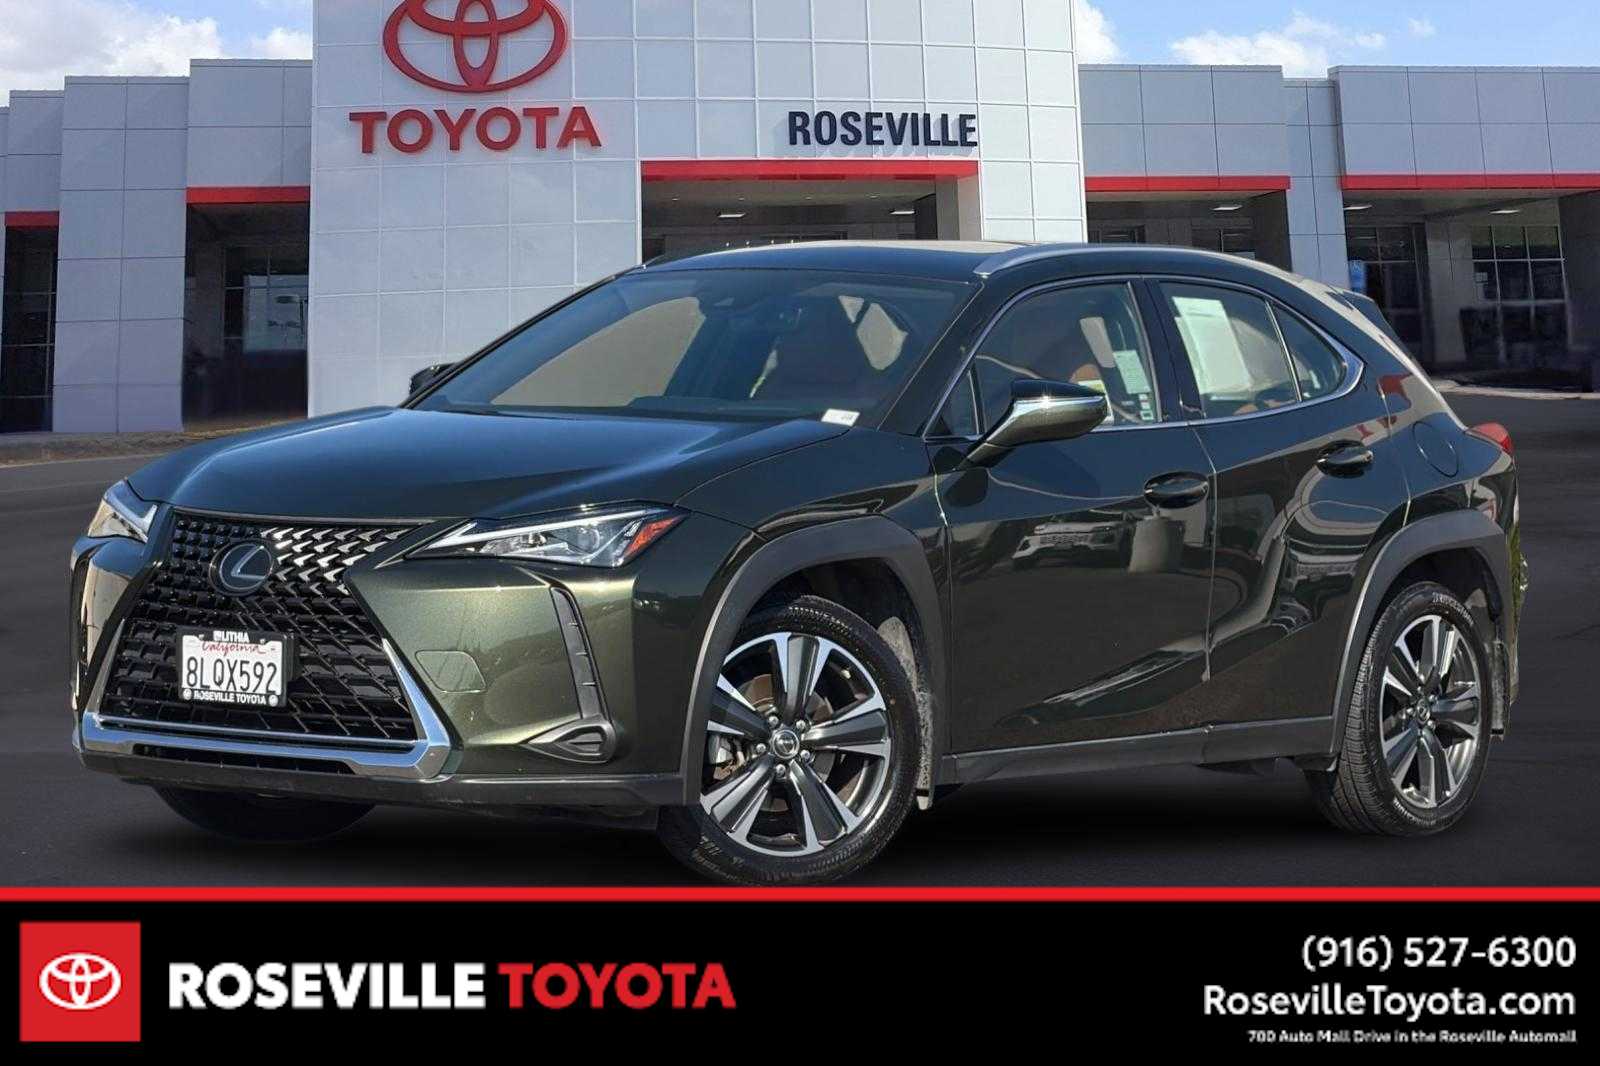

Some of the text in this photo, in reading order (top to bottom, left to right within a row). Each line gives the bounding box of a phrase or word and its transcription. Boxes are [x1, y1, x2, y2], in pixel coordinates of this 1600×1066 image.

[349, 105, 602, 154] TOYOTA
[788, 111, 978, 147] ROSEVILLE
[201, 641, 266, 657] California
[186, 656, 277, 695] 8LQX592
[193, 691, 267, 705] ROSEVILLE TOYOTA
